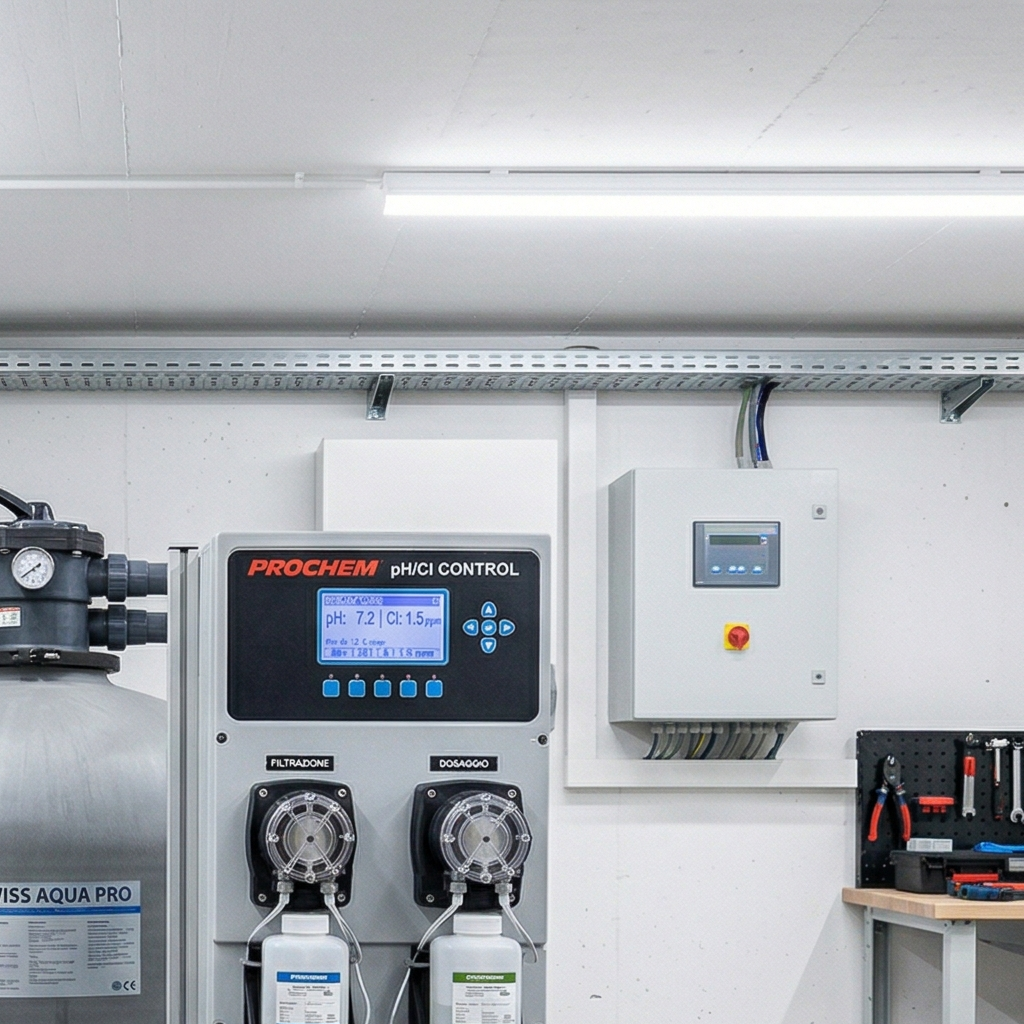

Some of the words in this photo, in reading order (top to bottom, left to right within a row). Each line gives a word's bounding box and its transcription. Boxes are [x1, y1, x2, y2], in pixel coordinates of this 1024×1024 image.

[247, 559, 379, 577] PROCHEM
[438, 562, 520, 576] CONTROL
[326, 611, 347, 628] pH:
[356, 611, 375, 625] 7.2
[406, 611, 424, 625] 1.5
[36, 887, 91, 905] AQUA
[95, 886, 132, 902] PRO
